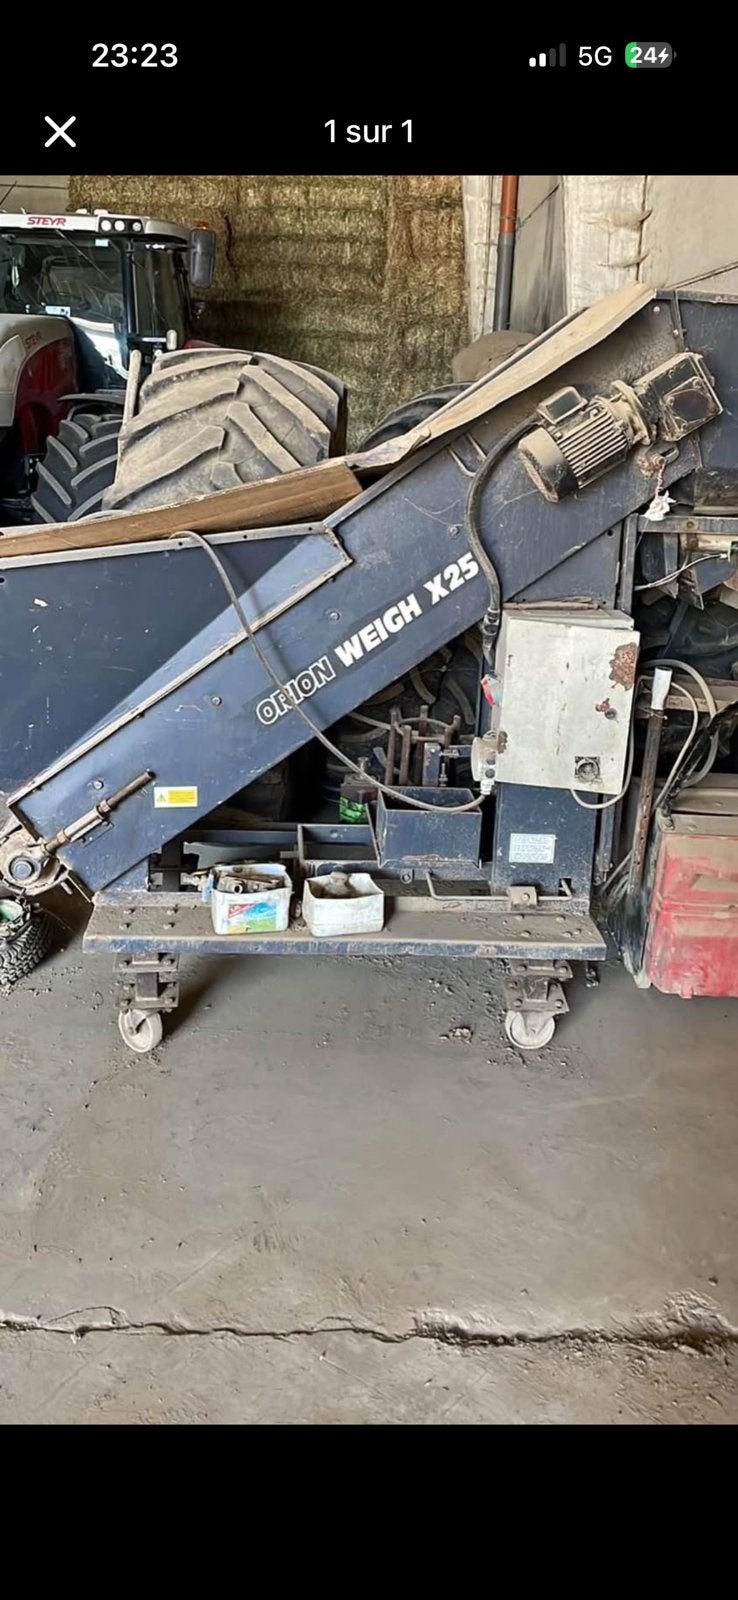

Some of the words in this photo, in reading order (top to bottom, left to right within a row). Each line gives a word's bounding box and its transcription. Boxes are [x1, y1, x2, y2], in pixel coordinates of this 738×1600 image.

[27, 215, 67, 228] STEYR
[256, 656, 336, 725] ORION
[334, 593, 423, 667] WEIGH
[423, 552, 480, 605] X25
